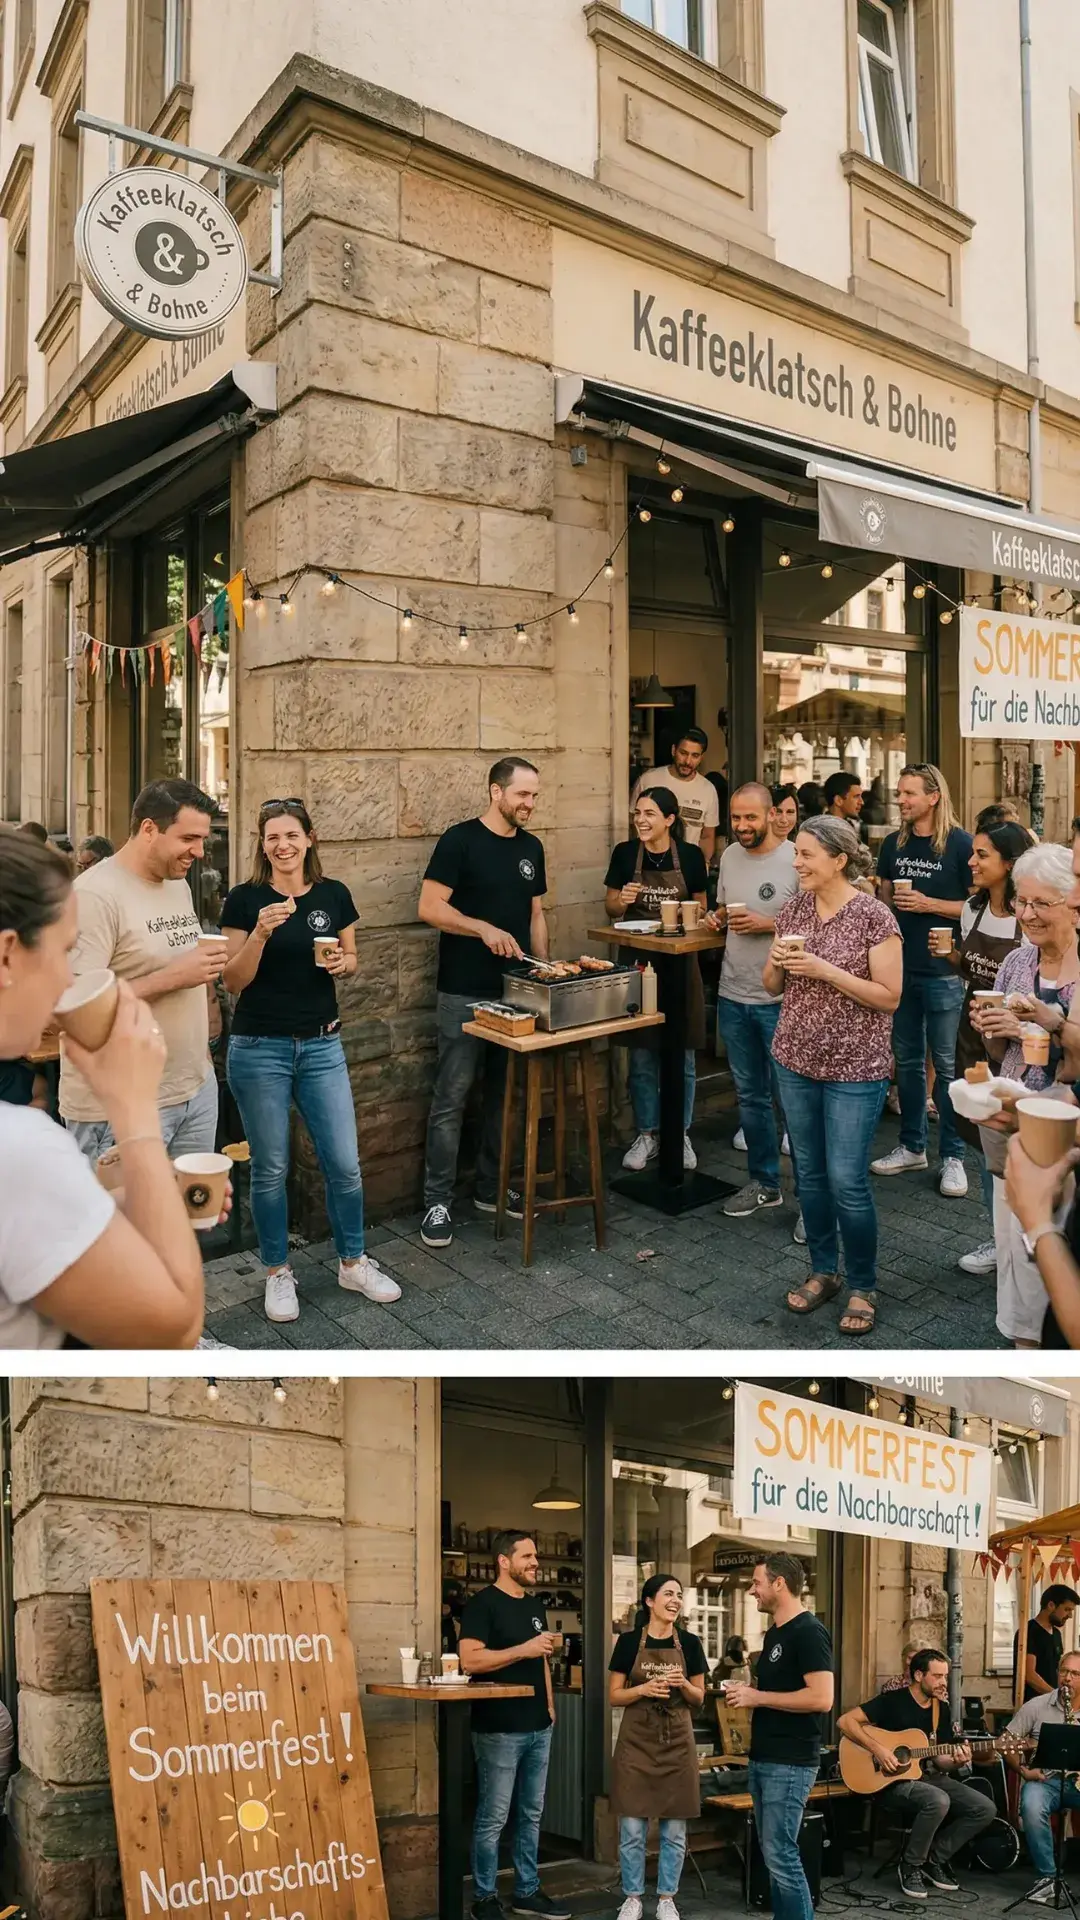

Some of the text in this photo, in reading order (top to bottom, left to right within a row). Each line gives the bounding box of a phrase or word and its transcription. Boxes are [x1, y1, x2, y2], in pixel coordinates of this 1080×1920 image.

[97, 184, 235, 256] Kaffeeklatsch
[126, 283, 208, 320] & Bohne
[634, 289, 957, 452] Kaffeeklatsch & Bohne
[992, 530, 1080, 582] Kaffeeklatsc
[974, 619, 1080, 682] SOMMER
[971, 686, 1080, 731] für die Nachb
[754, 1399, 975, 1495] SOMMERFEST
[752, 1467, 786, 1514] für
[796, 1477, 828, 1513] die
[115, 1612, 333, 1665] Willkommen
[202, 1680, 267, 1714] beim
[140, 1841, 376, 1914] Nachbarschafts-
